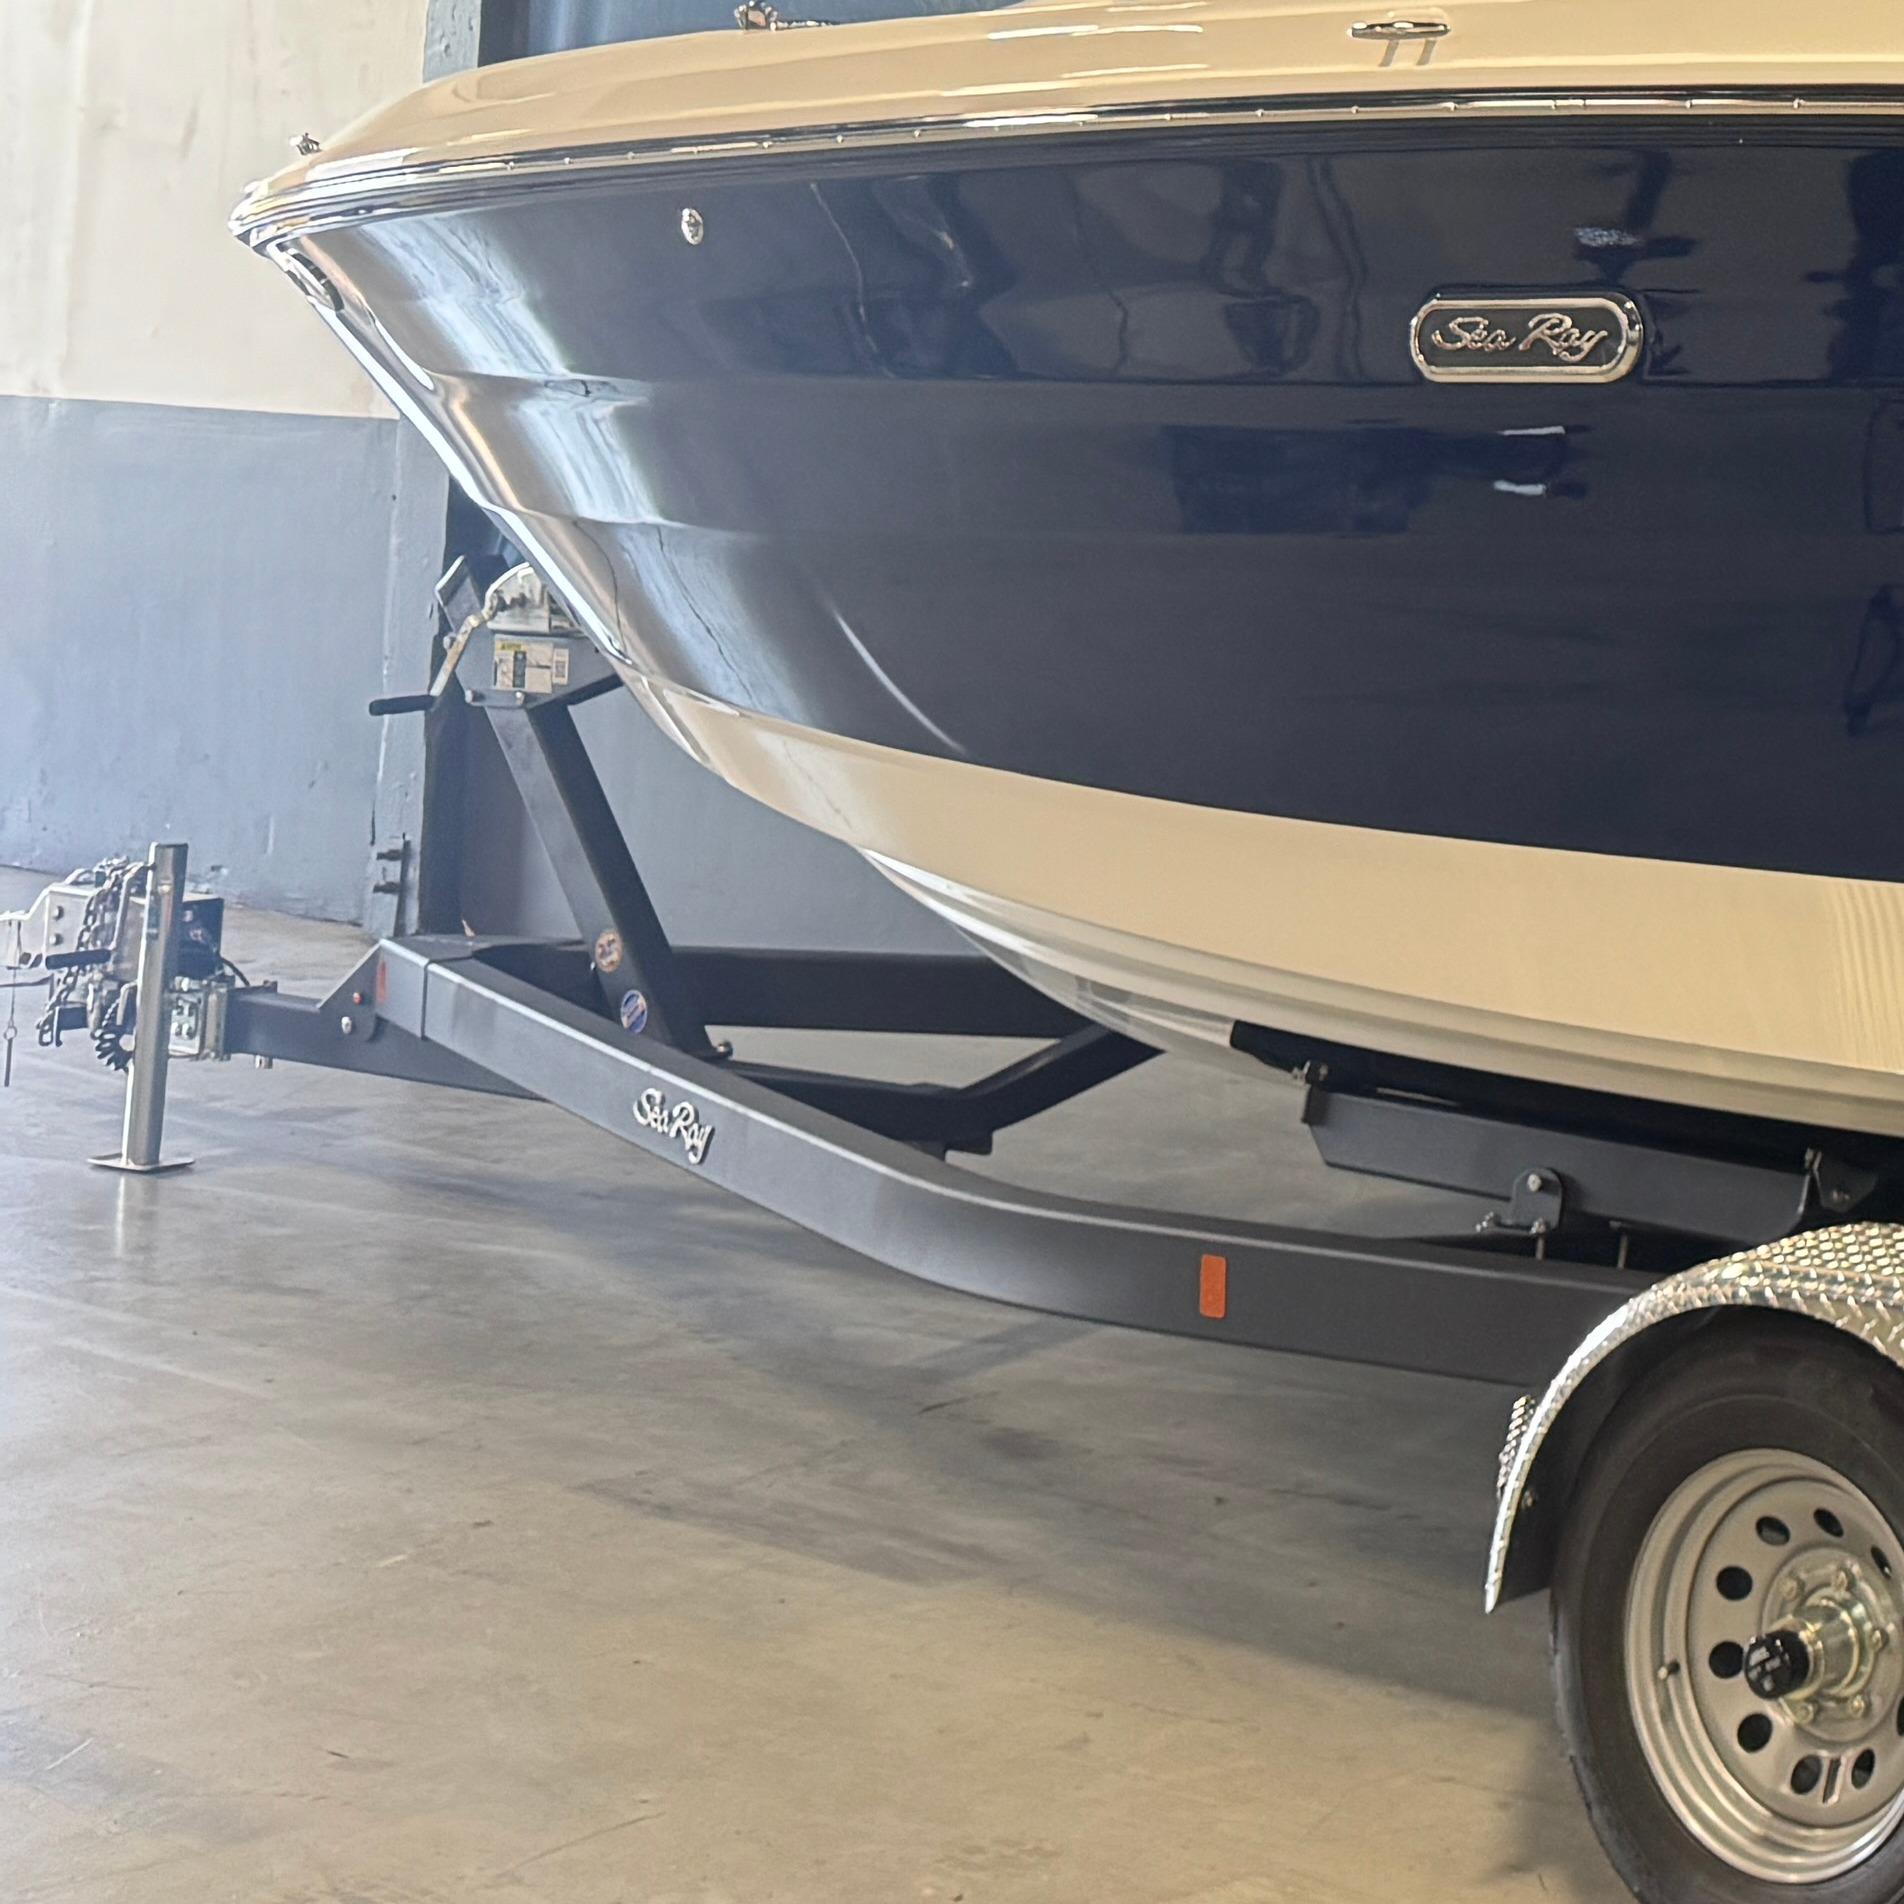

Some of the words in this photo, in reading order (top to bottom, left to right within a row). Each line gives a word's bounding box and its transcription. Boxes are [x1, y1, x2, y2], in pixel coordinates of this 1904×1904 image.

[1431, 316, 1516, 352] Sea
[1519, 312, 1608, 363] Ray
[633, 1088, 670, 1133] Sea
[669, 1101, 713, 1164] Ray
